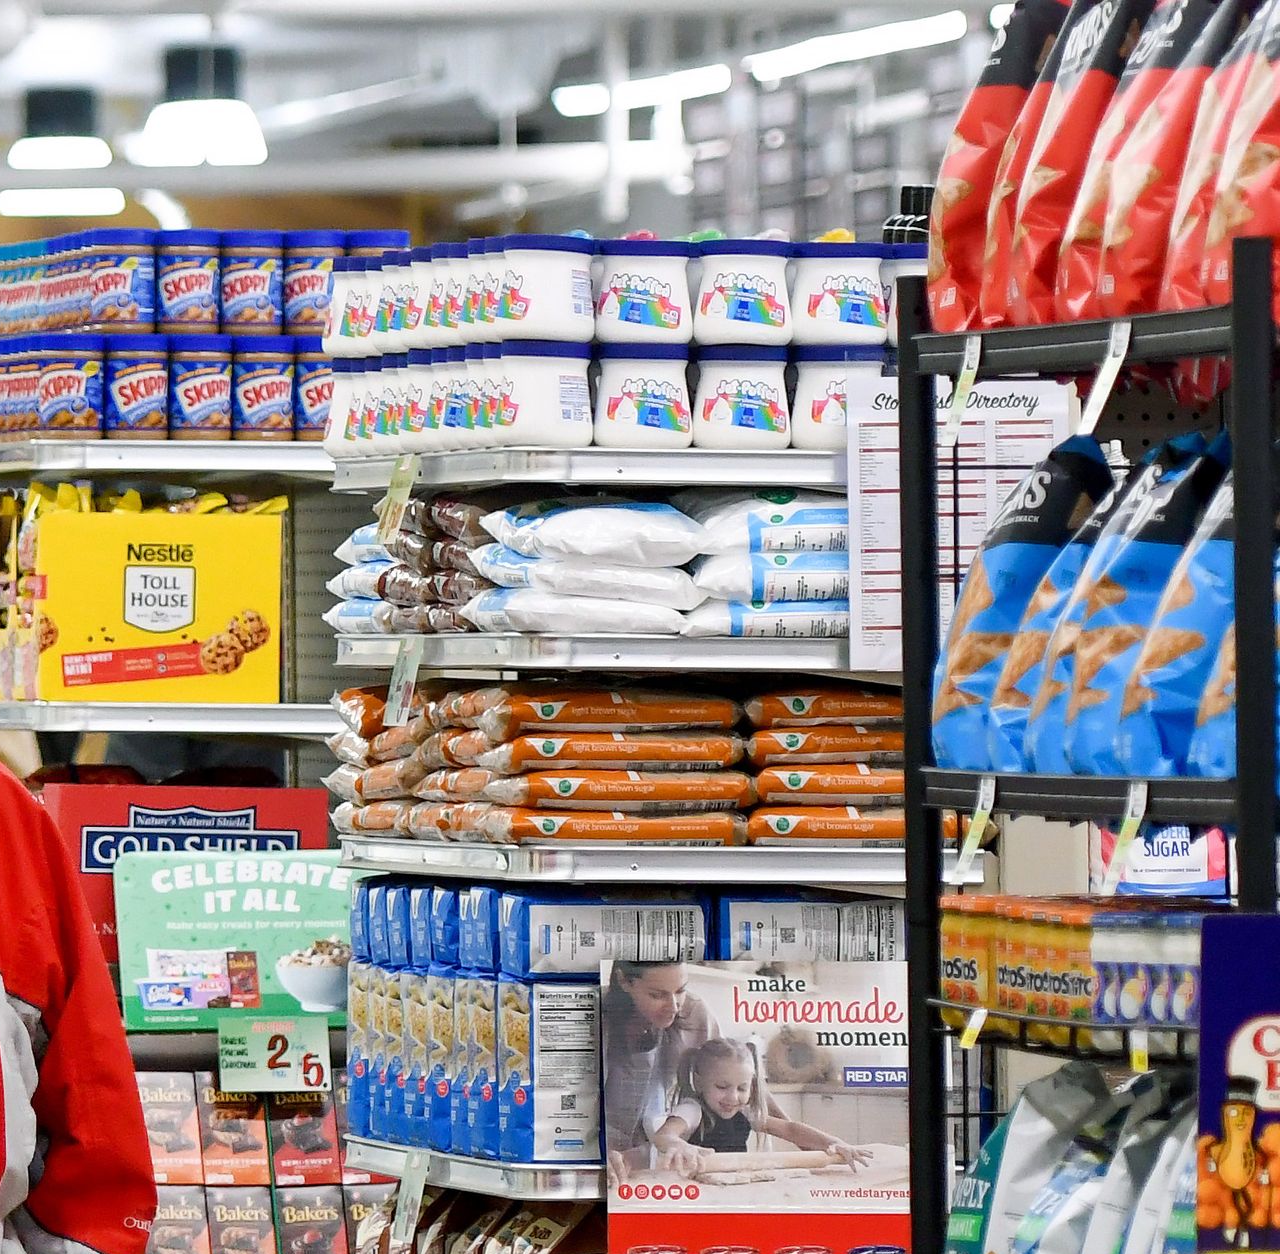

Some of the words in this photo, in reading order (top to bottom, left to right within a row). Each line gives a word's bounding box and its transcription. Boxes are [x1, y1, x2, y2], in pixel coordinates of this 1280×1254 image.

[872, 393, 900, 410] Sto
[966, 391, 1040, 416] Directory
[140, 574, 181, 590] TOLL
[131, 592, 189, 608] HOUSE
[1143, 841, 1190, 857] SUGAR
[151, 860, 353, 893] CELEBRATE
[204, 889, 237, 914] IT
[242, 888, 301, 913] ALL
[748, 975, 806, 992] make
[732, 986, 904, 1024] homemade
[267, 1034, 291, 1070] 2
[846, 1071, 871, 1083] RED
[874, 1071, 908, 1083] STAR
[155, 1204, 203, 1220] aker's
[213, 1204, 269, 1222] Baker's
[282, 1204, 339, 1224] Baker's
